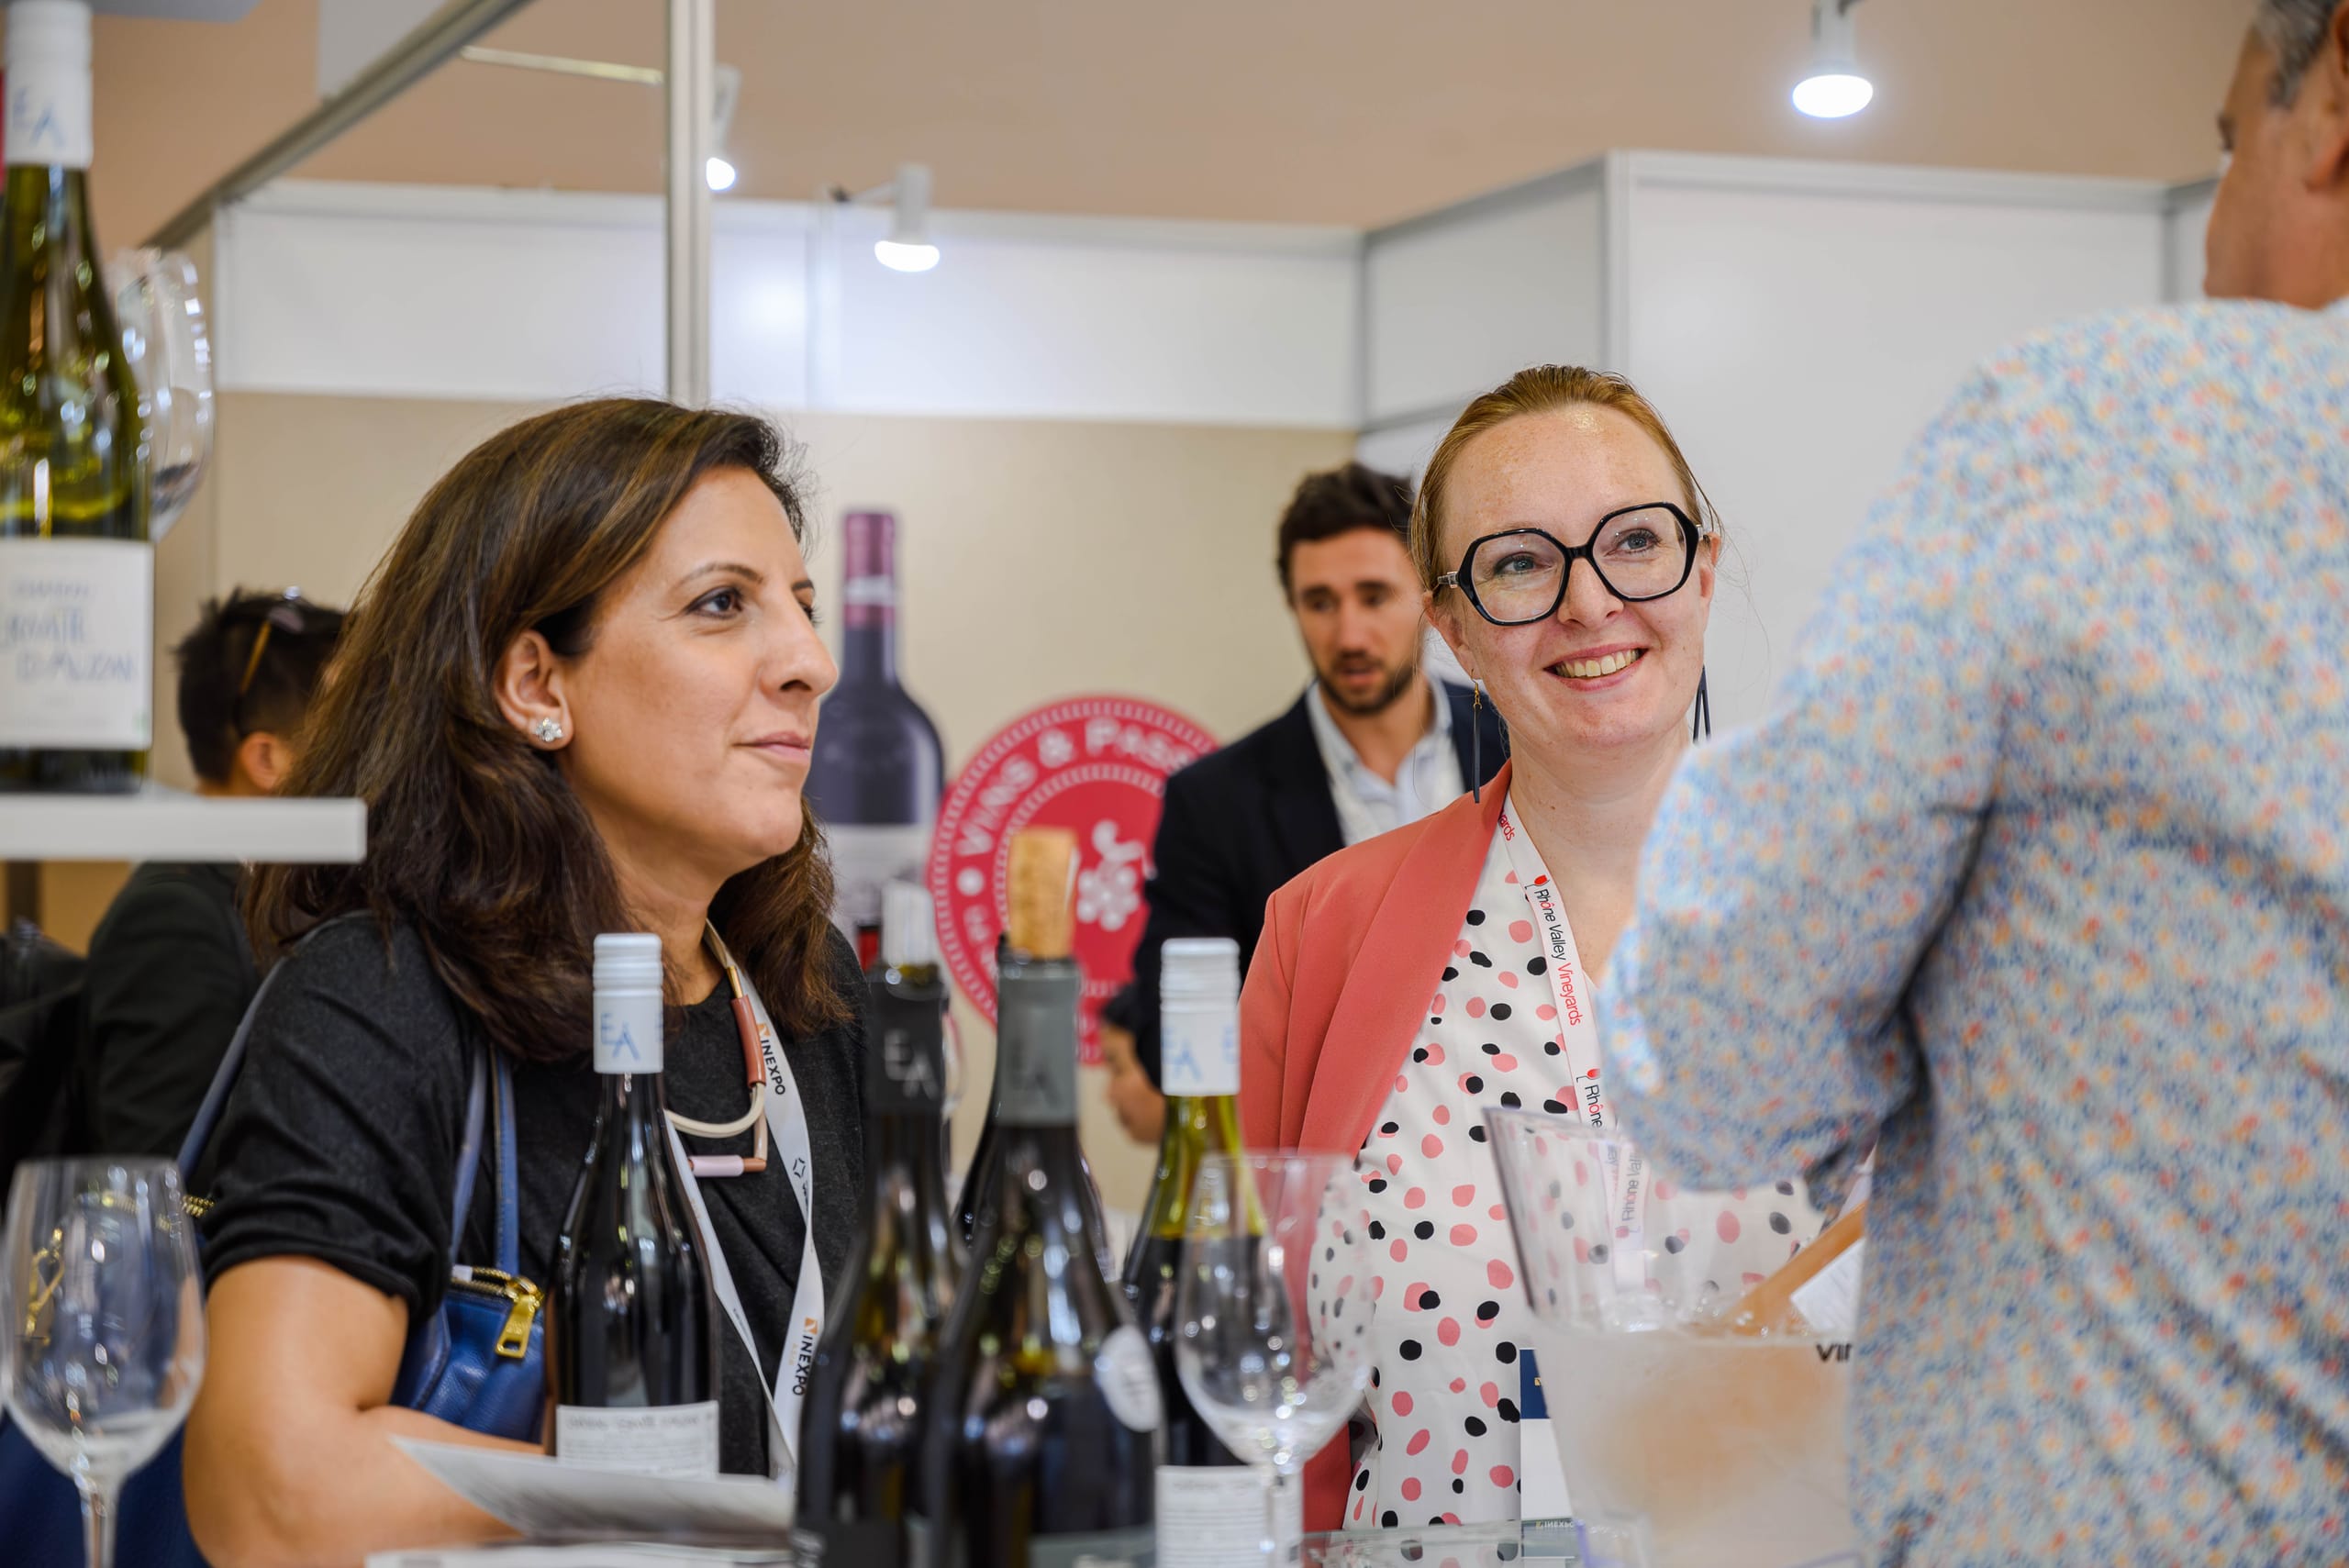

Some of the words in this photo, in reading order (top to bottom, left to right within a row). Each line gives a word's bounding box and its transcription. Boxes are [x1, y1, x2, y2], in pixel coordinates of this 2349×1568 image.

[1037, 729, 1074, 770] &
[1534, 889, 1555, 922] Rhône
[1549, 924, 1566, 961] Valley
[1557, 962, 1584, 1026] Vineyards
[1585, 1084, 1602, 1129] Rhône
